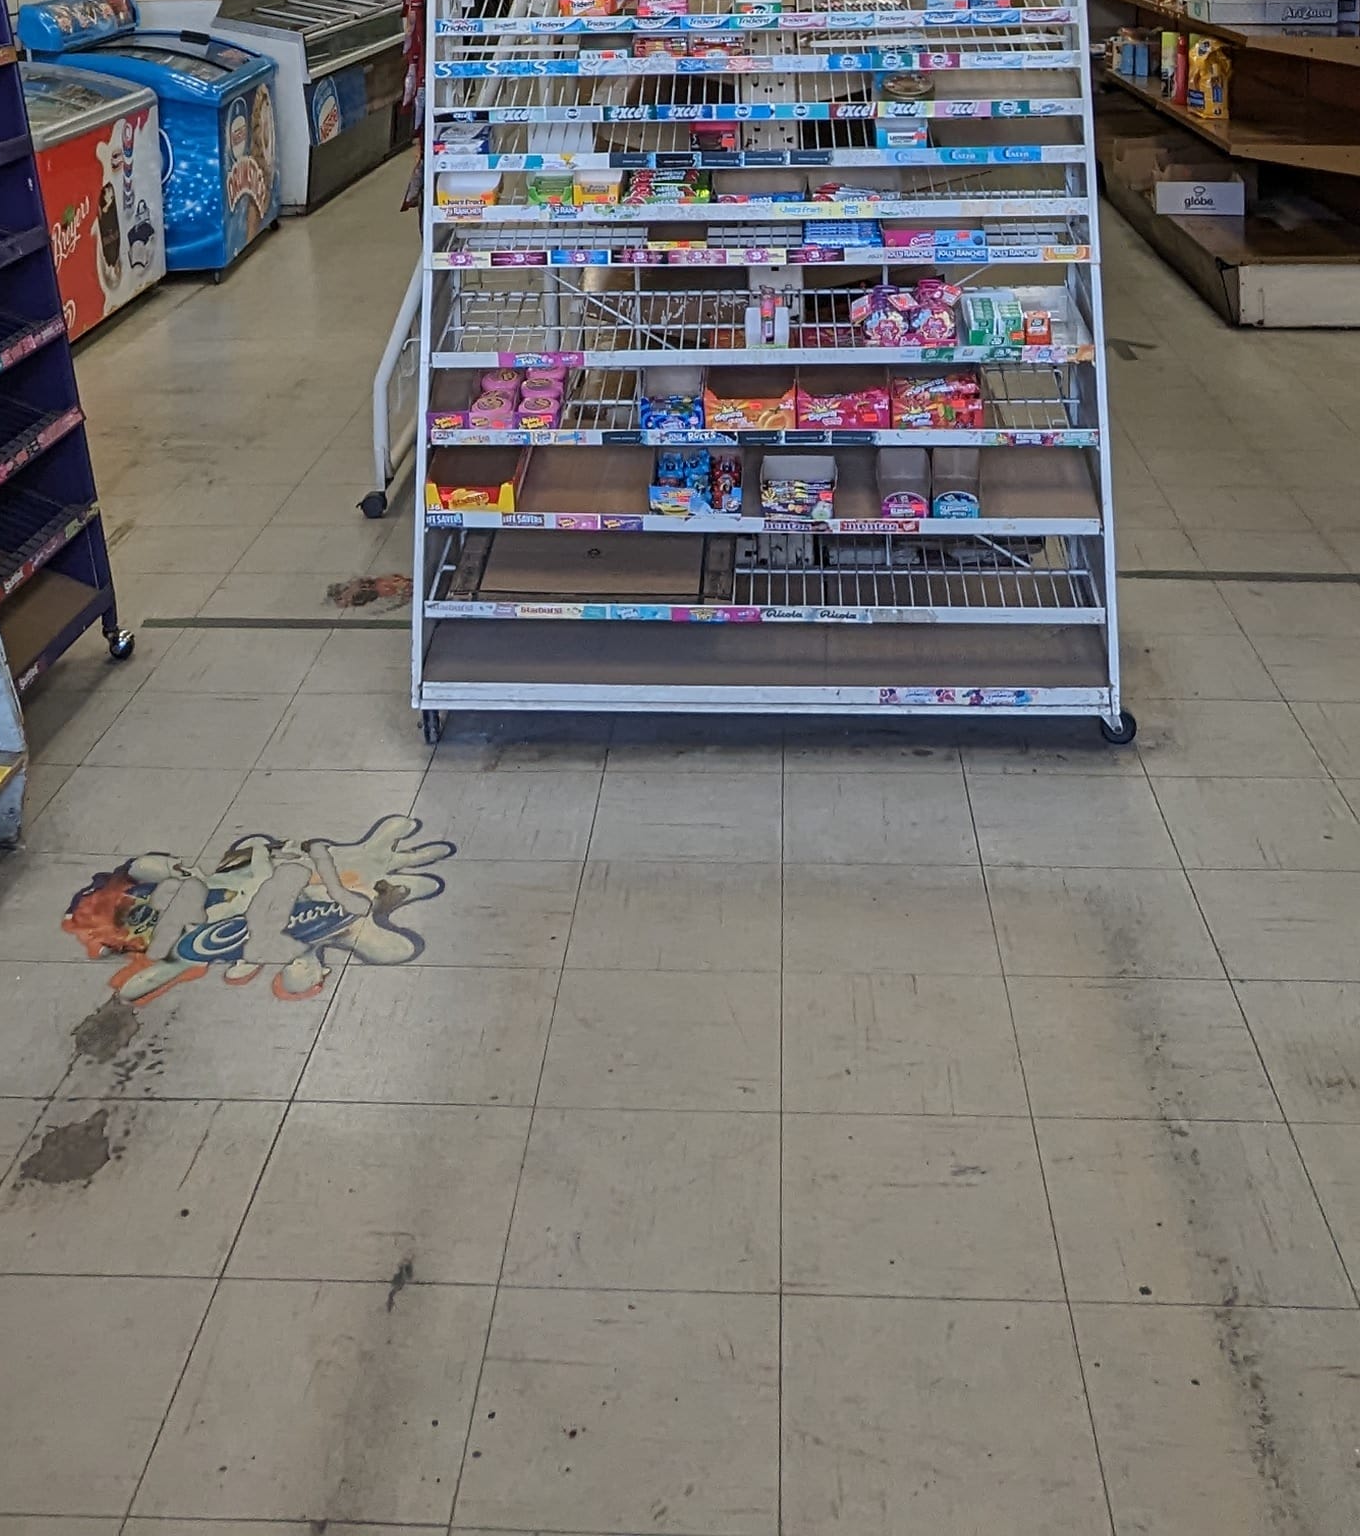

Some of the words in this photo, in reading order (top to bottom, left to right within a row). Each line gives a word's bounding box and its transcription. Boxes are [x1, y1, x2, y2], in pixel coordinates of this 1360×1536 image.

[570, 0, 595, 9] Trident
[586, 20, 616, 28] Trident
[690, 17, 720, 25] Trident
[831, 15, 856, 23] Trident
[441, 24, 477, 32] Trident
[535, 21, 565, 29] Trident
[610, 105, 648, 120] excel
[668, 105, 701, 119] excel
[836, 103, 876, 117] excel
[888, 101, 924, 115] excel
[945, 101, 980, 114] excel
[497, 108, 532, 121] excel
[1184, 196, 1214, 208] globe
[903, 248, 932, 258] RANCHER
[939, 250, 955, 259] JOLLY
[955, 248, 987, 257] RANCHER
[992, 250, 1008, 258] JOLLY
[1009, 248, 1037, 257] RANCHER
[440, 514, 463, 523] SAVERS
[520, 515, 543, 524] SAVERS
[843, 520, 899, 531] mentos
[765, 610, 803, 618] Ricola
[820, 610, 857, 619] Ricola
